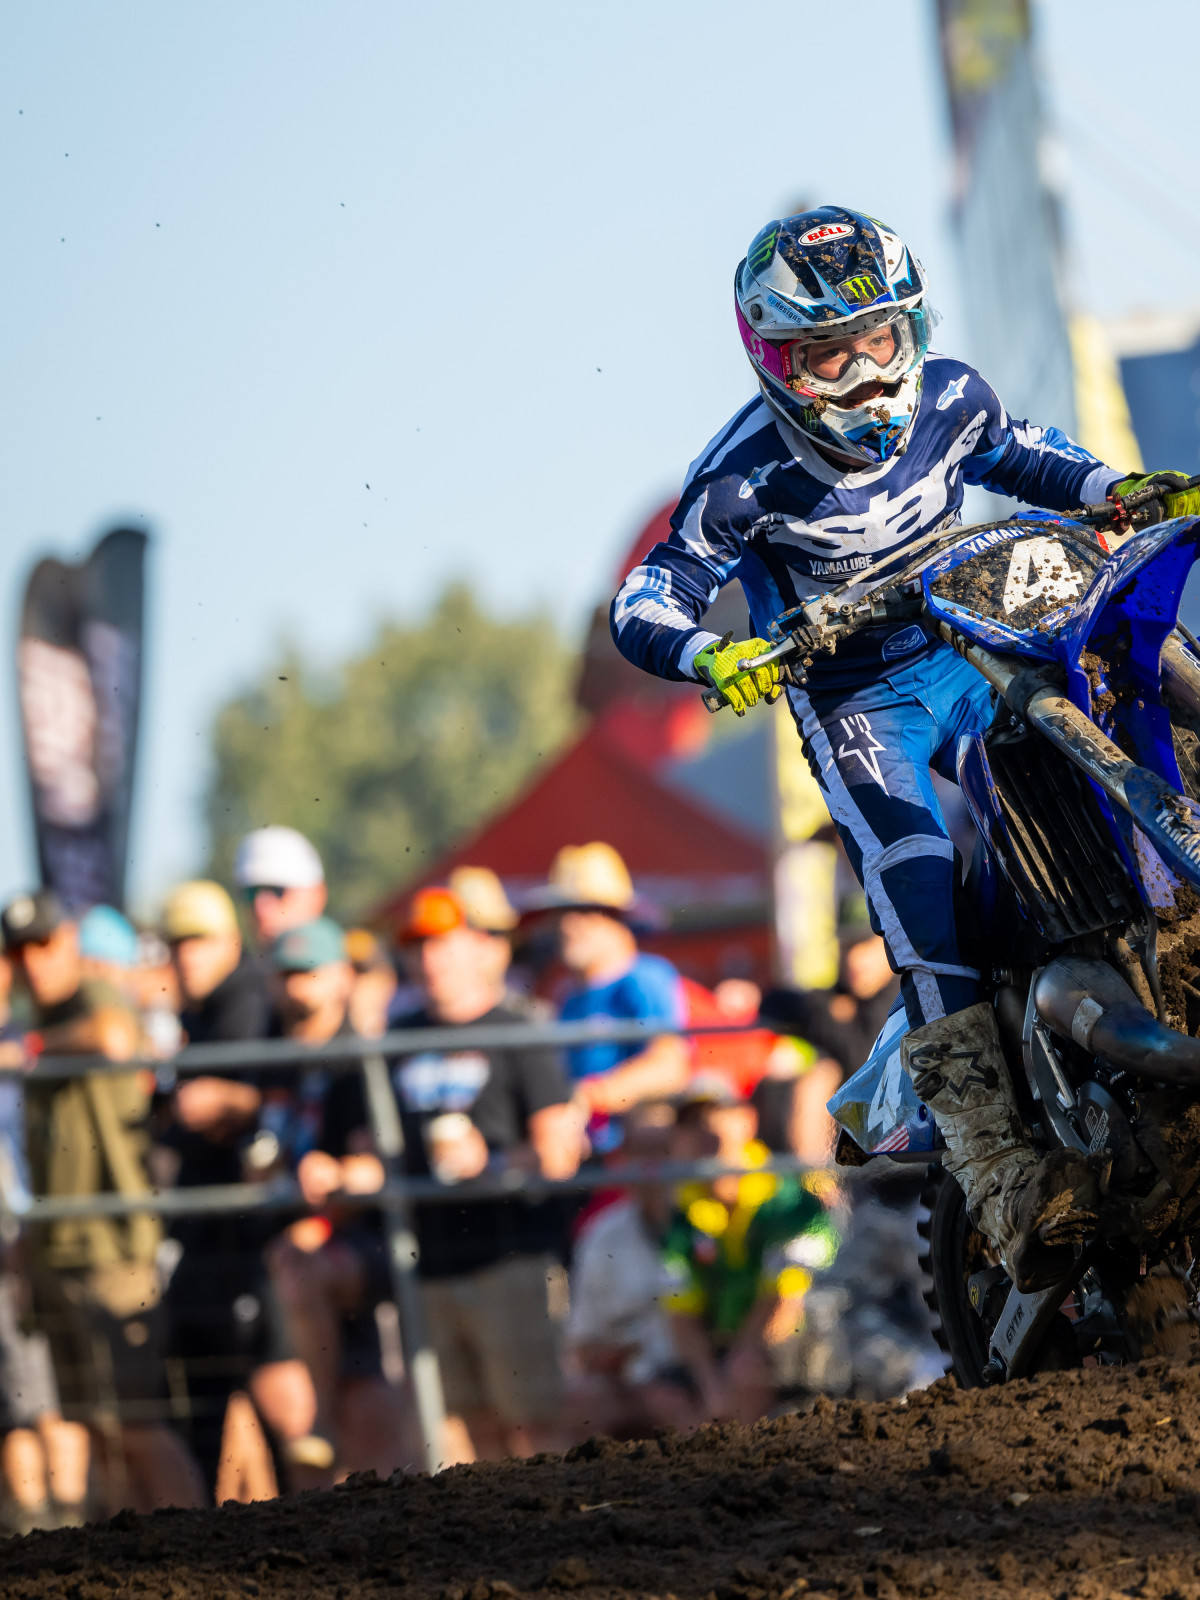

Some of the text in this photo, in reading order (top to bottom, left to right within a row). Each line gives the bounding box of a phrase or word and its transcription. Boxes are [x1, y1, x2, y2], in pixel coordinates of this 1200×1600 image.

[807, 226, 847, 242] BELL
[809, 554, 874, 576] YAMALUBE
[1003, 535, 1084, 616] 4
[866, 1046, 904, 1135] 4
